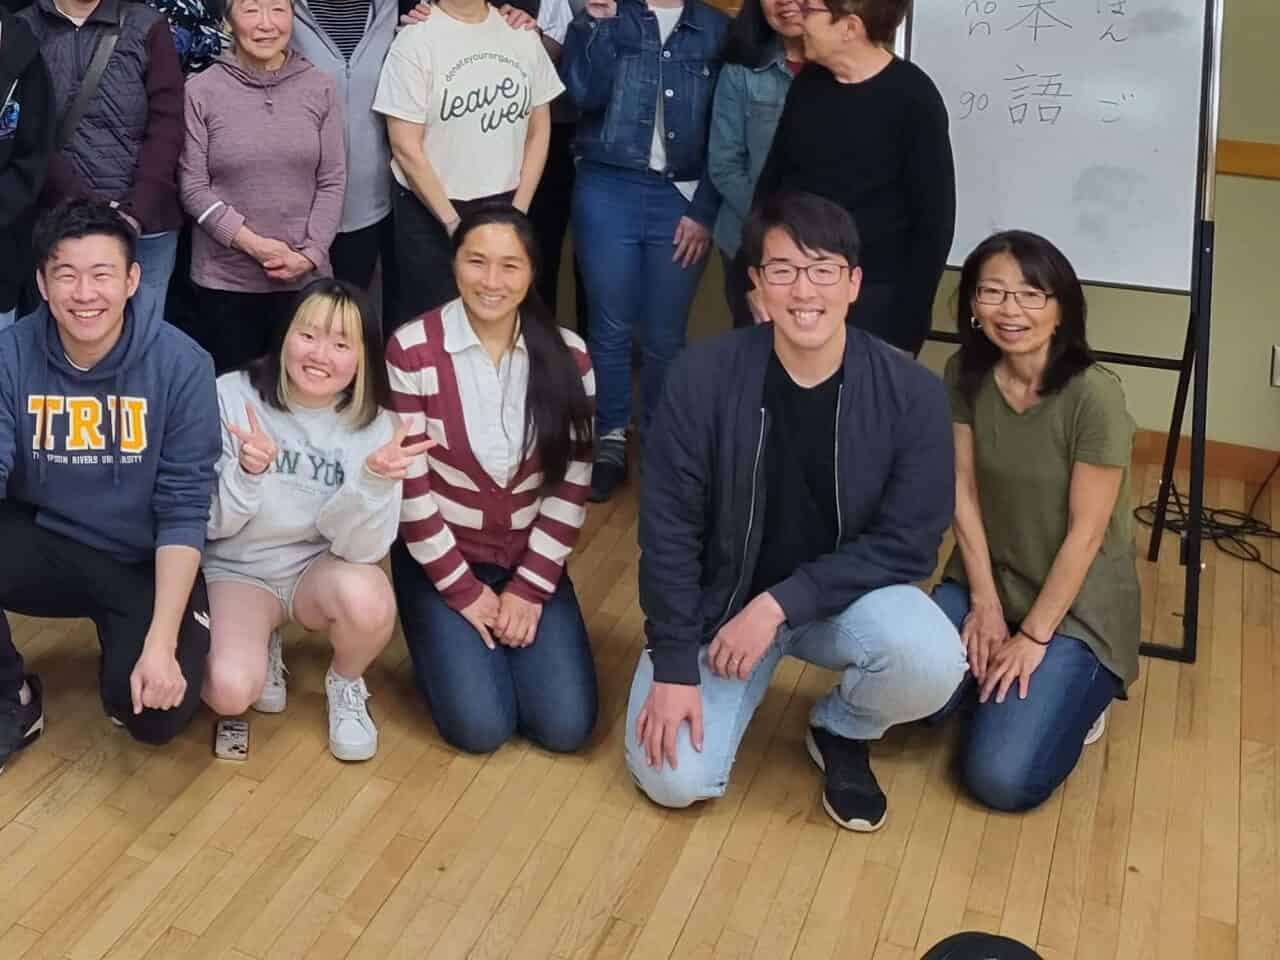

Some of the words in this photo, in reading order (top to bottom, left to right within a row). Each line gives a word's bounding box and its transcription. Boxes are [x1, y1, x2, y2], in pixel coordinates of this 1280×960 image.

[440, 77, 519, 121] leave
[481, 85, 532, 133] well
[959, 91, 989, 120] go
[1003, 63, 1073, 125] 語
[1098, 92, 1136, 123] ご
[28, 395, 148, 453] TRU
[72, 455, 98, 464] RIVERS
[102, 455, 143, 465] UNIRSITY
